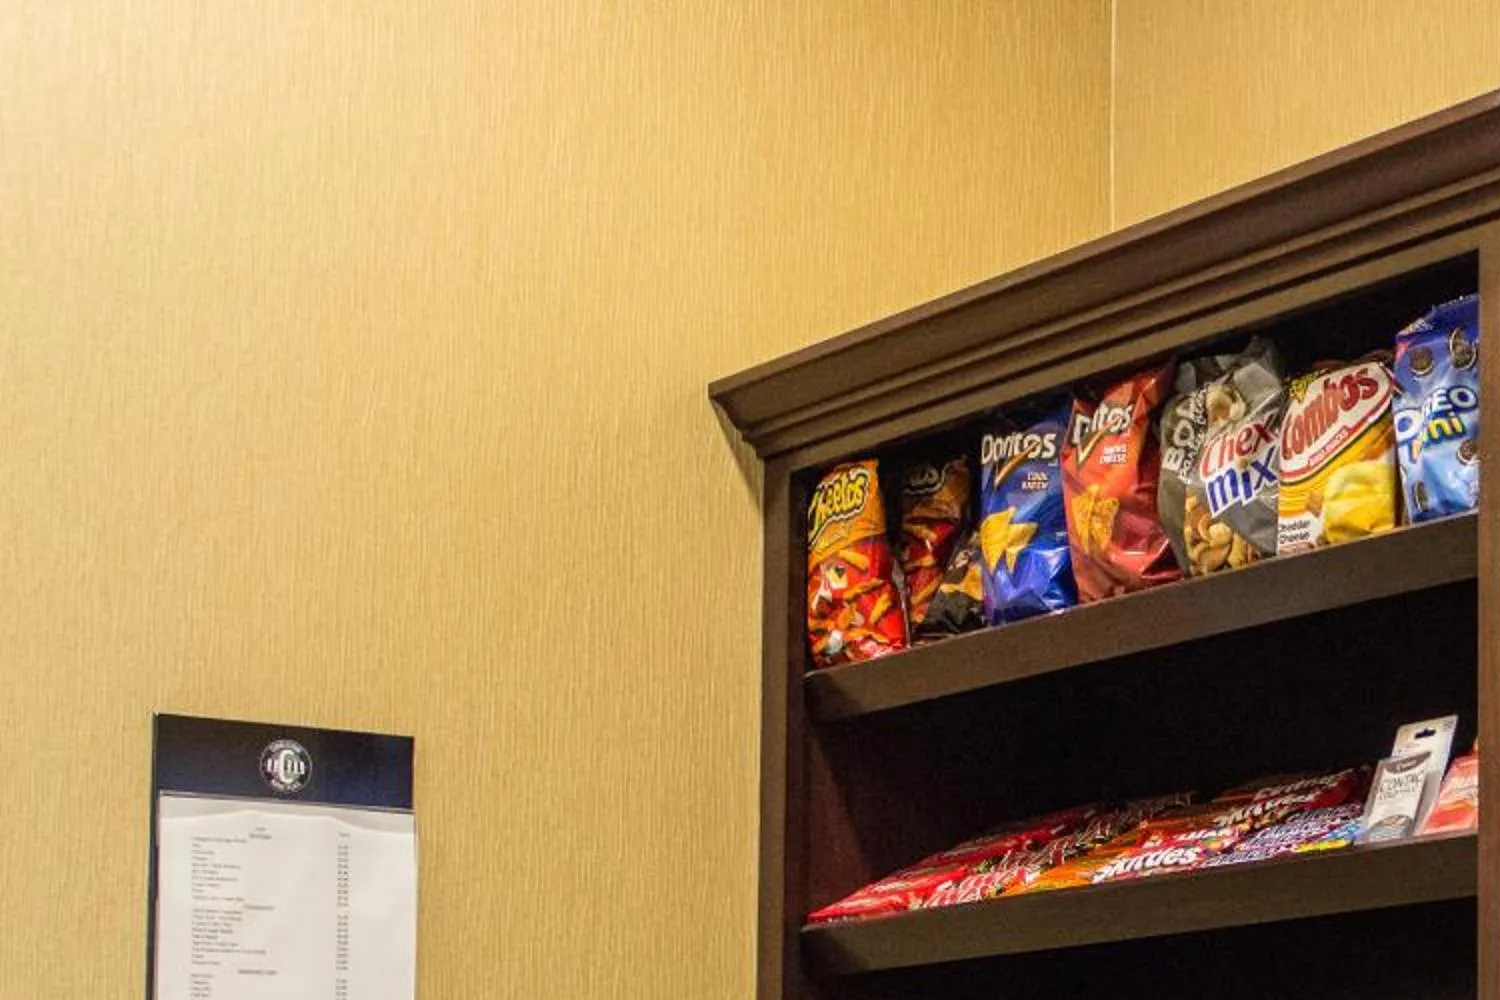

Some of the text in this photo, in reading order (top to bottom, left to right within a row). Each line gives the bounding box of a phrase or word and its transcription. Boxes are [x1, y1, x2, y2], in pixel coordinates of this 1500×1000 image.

[1283, 368, 1378, 460] Combos
[1394, 387, 1477, 440] OEO
[981, 432, 1056, 466] Doritos
[1202, 411, 1276, 478] Chex
